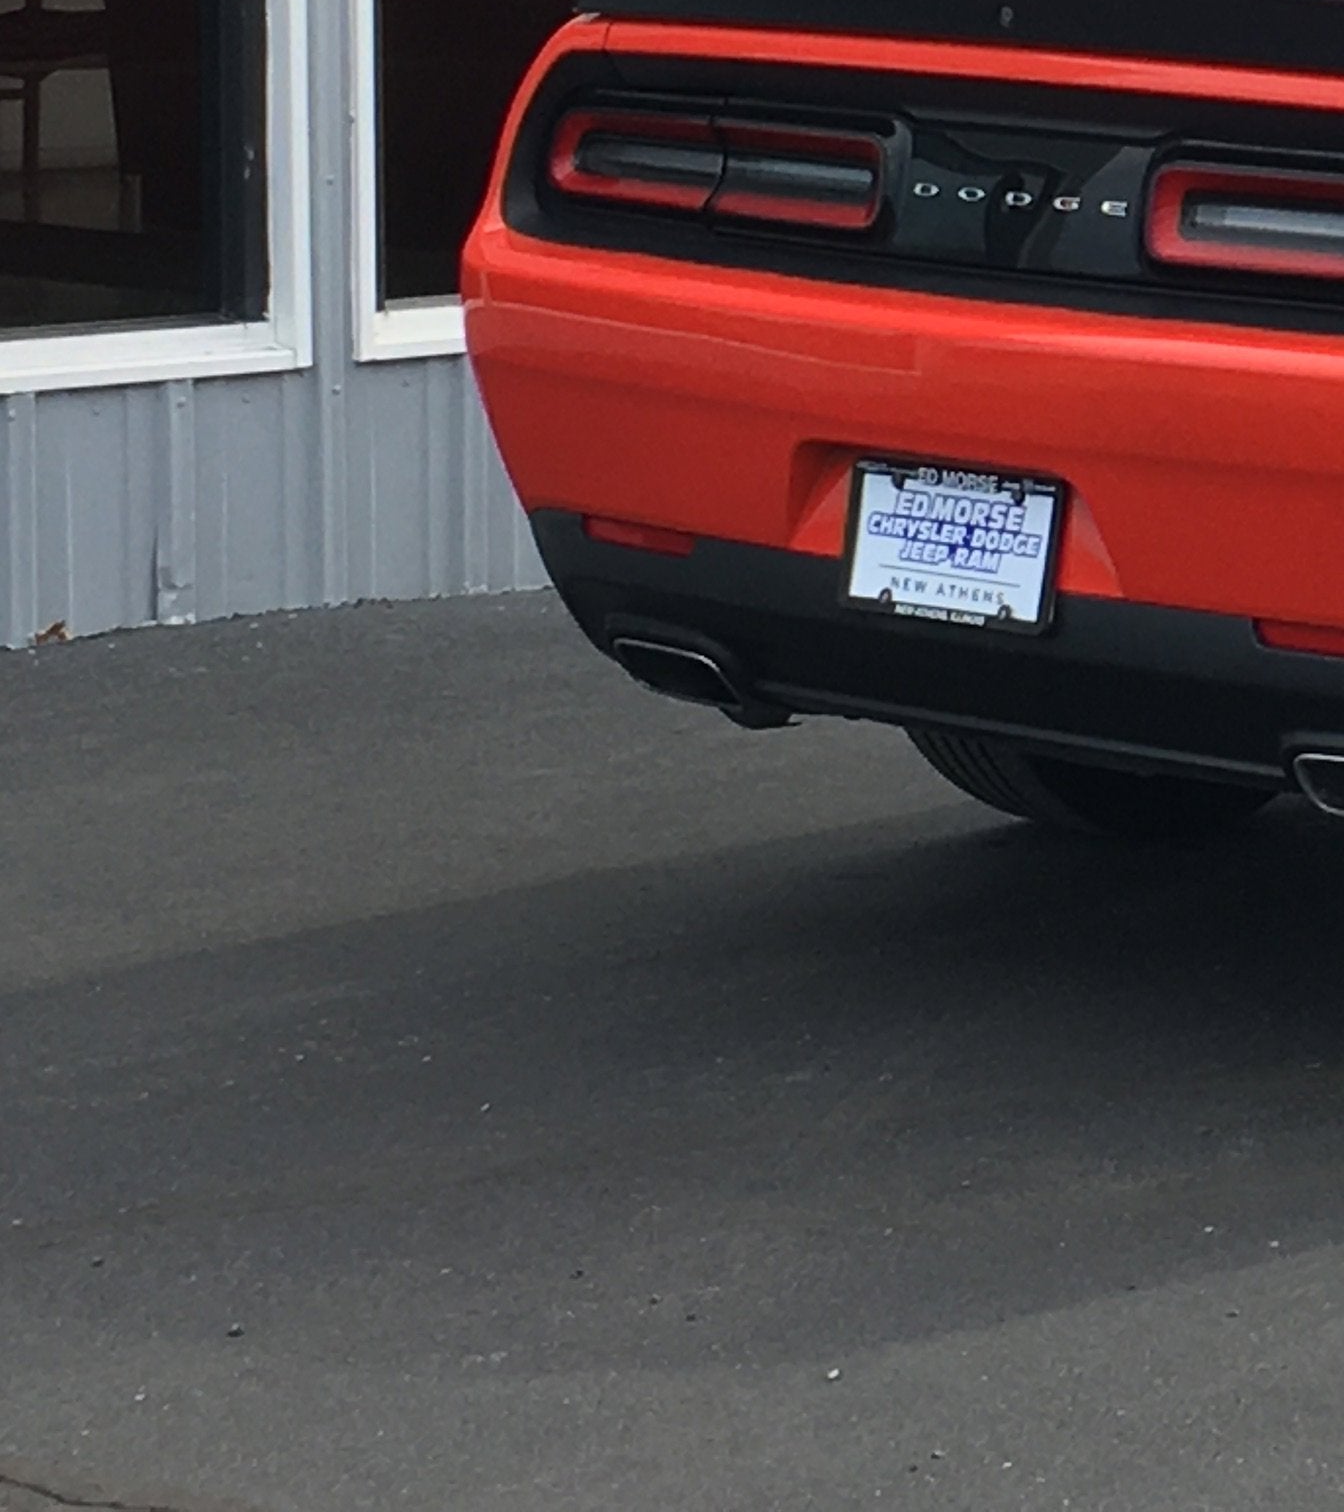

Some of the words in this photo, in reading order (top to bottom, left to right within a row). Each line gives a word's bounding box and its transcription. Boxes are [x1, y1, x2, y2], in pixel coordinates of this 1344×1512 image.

[912, 182, 1129, 218] DODGE
[917, 466, 938, 485] ED
[942, 470, 999, 494] MORSE
[895, 489, 930, 519] ED
[930, 496, 1027, 533] MORSE
[868, 511, 967, 547] CHRYSLER
[970, 527, 1043, 559] DODGE
[899, 538, 950, 566] JEEP
[951, 545, 1001, 574] RAM
[890, 576, 928, 594] NEW
[935, 582, 1006, 605] ATHENS
